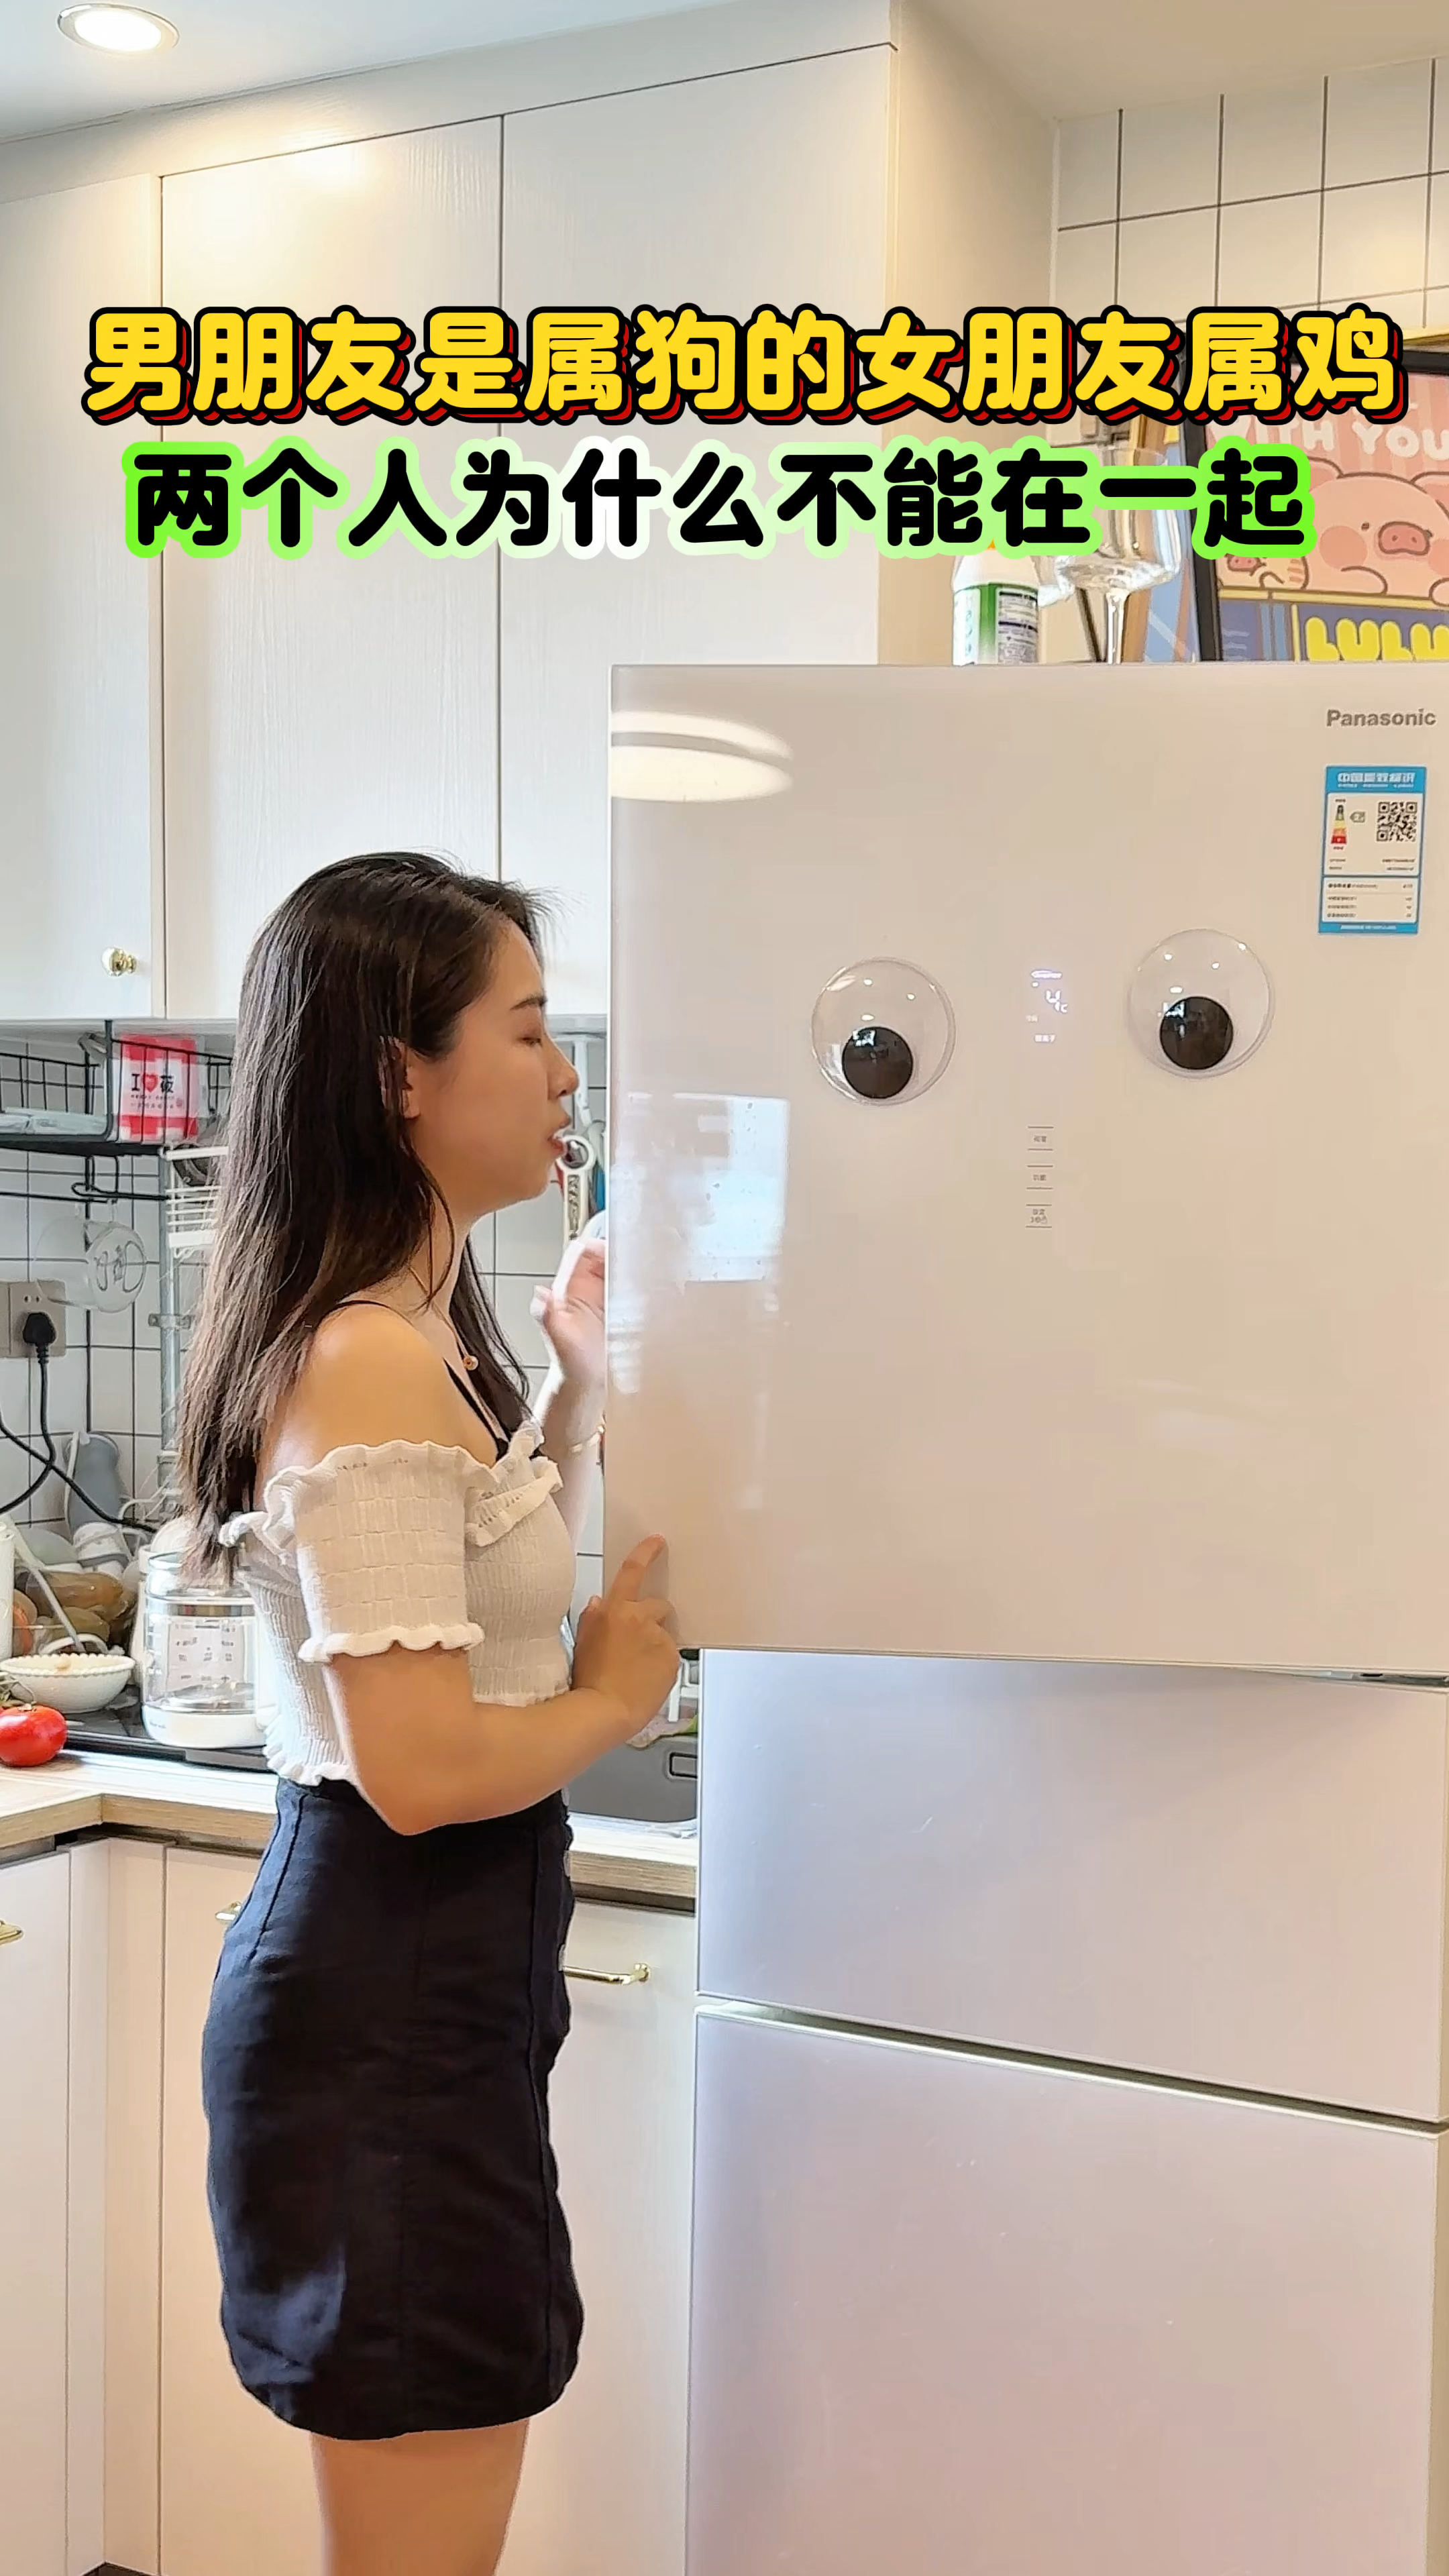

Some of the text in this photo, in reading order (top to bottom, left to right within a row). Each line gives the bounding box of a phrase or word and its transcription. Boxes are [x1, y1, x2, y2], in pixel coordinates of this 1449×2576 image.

[1352, 420, 1449, 461] YOU
[1305, 615, 1449, 661] LULU
[1326, 708, 1436, 727] Panasonic
